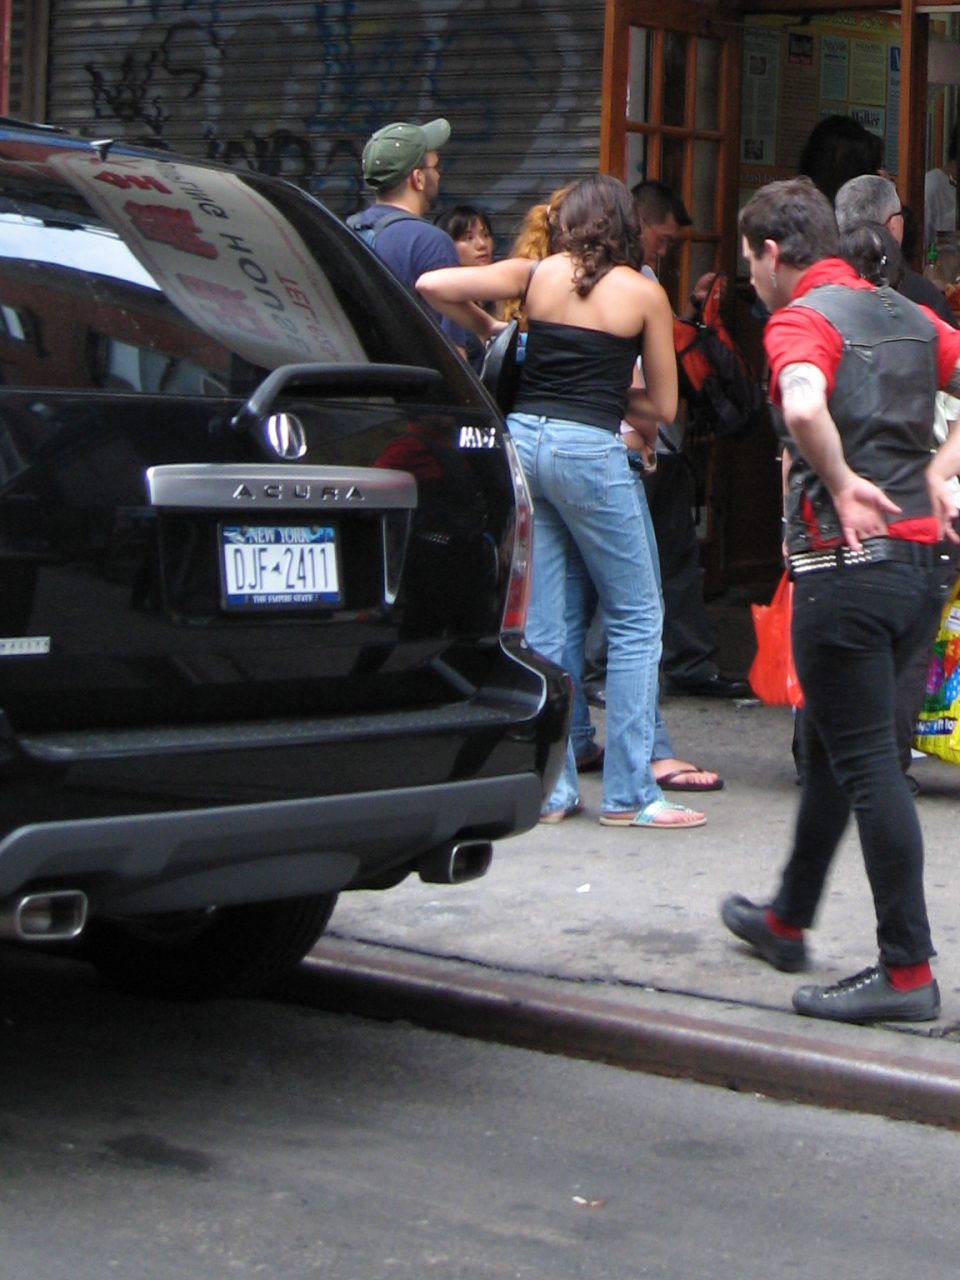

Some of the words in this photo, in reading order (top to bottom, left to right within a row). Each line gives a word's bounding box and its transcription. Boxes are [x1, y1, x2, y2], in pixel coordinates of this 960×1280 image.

[232, 483, 365, 501] ACURA
[249, 527, 275, 544] NEW
[279, 527, 310, 544] YORK
